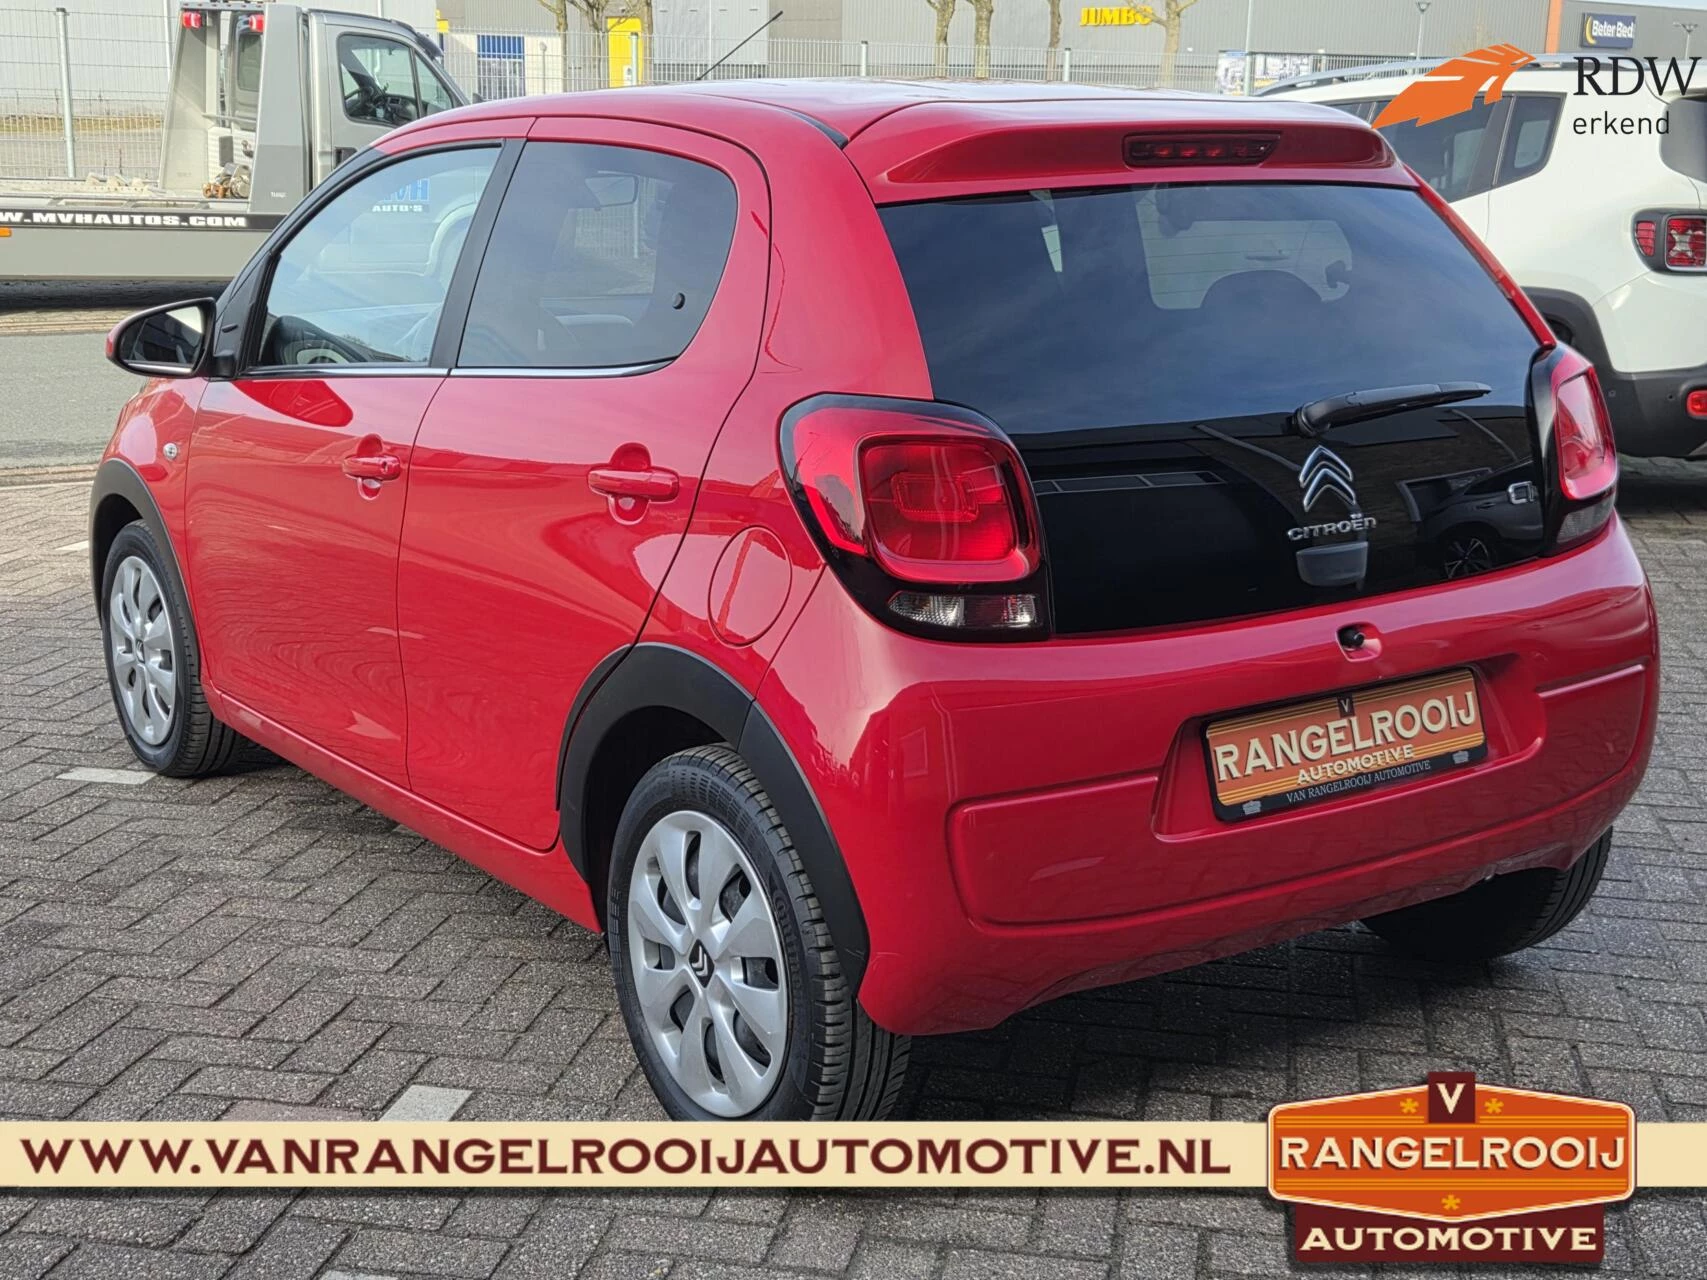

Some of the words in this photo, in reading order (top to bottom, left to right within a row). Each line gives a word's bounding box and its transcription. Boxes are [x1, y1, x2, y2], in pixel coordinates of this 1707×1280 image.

[1592, 19, 1615, 37] Beter
[1616, 21, 1634, 38] Bed
[1341, 699, 1351, 713] V
[1214, 691, 1477, 782] RANGELROOIJ
[1286, 788, 1306, 804] VAN
[1307, 774, 1372, 798] RANGELROOIJ
[1373, 760, 1432, 784] AUTOMOTIVE
[1297, 743, 1416, 786] AUTOMOTIVE
